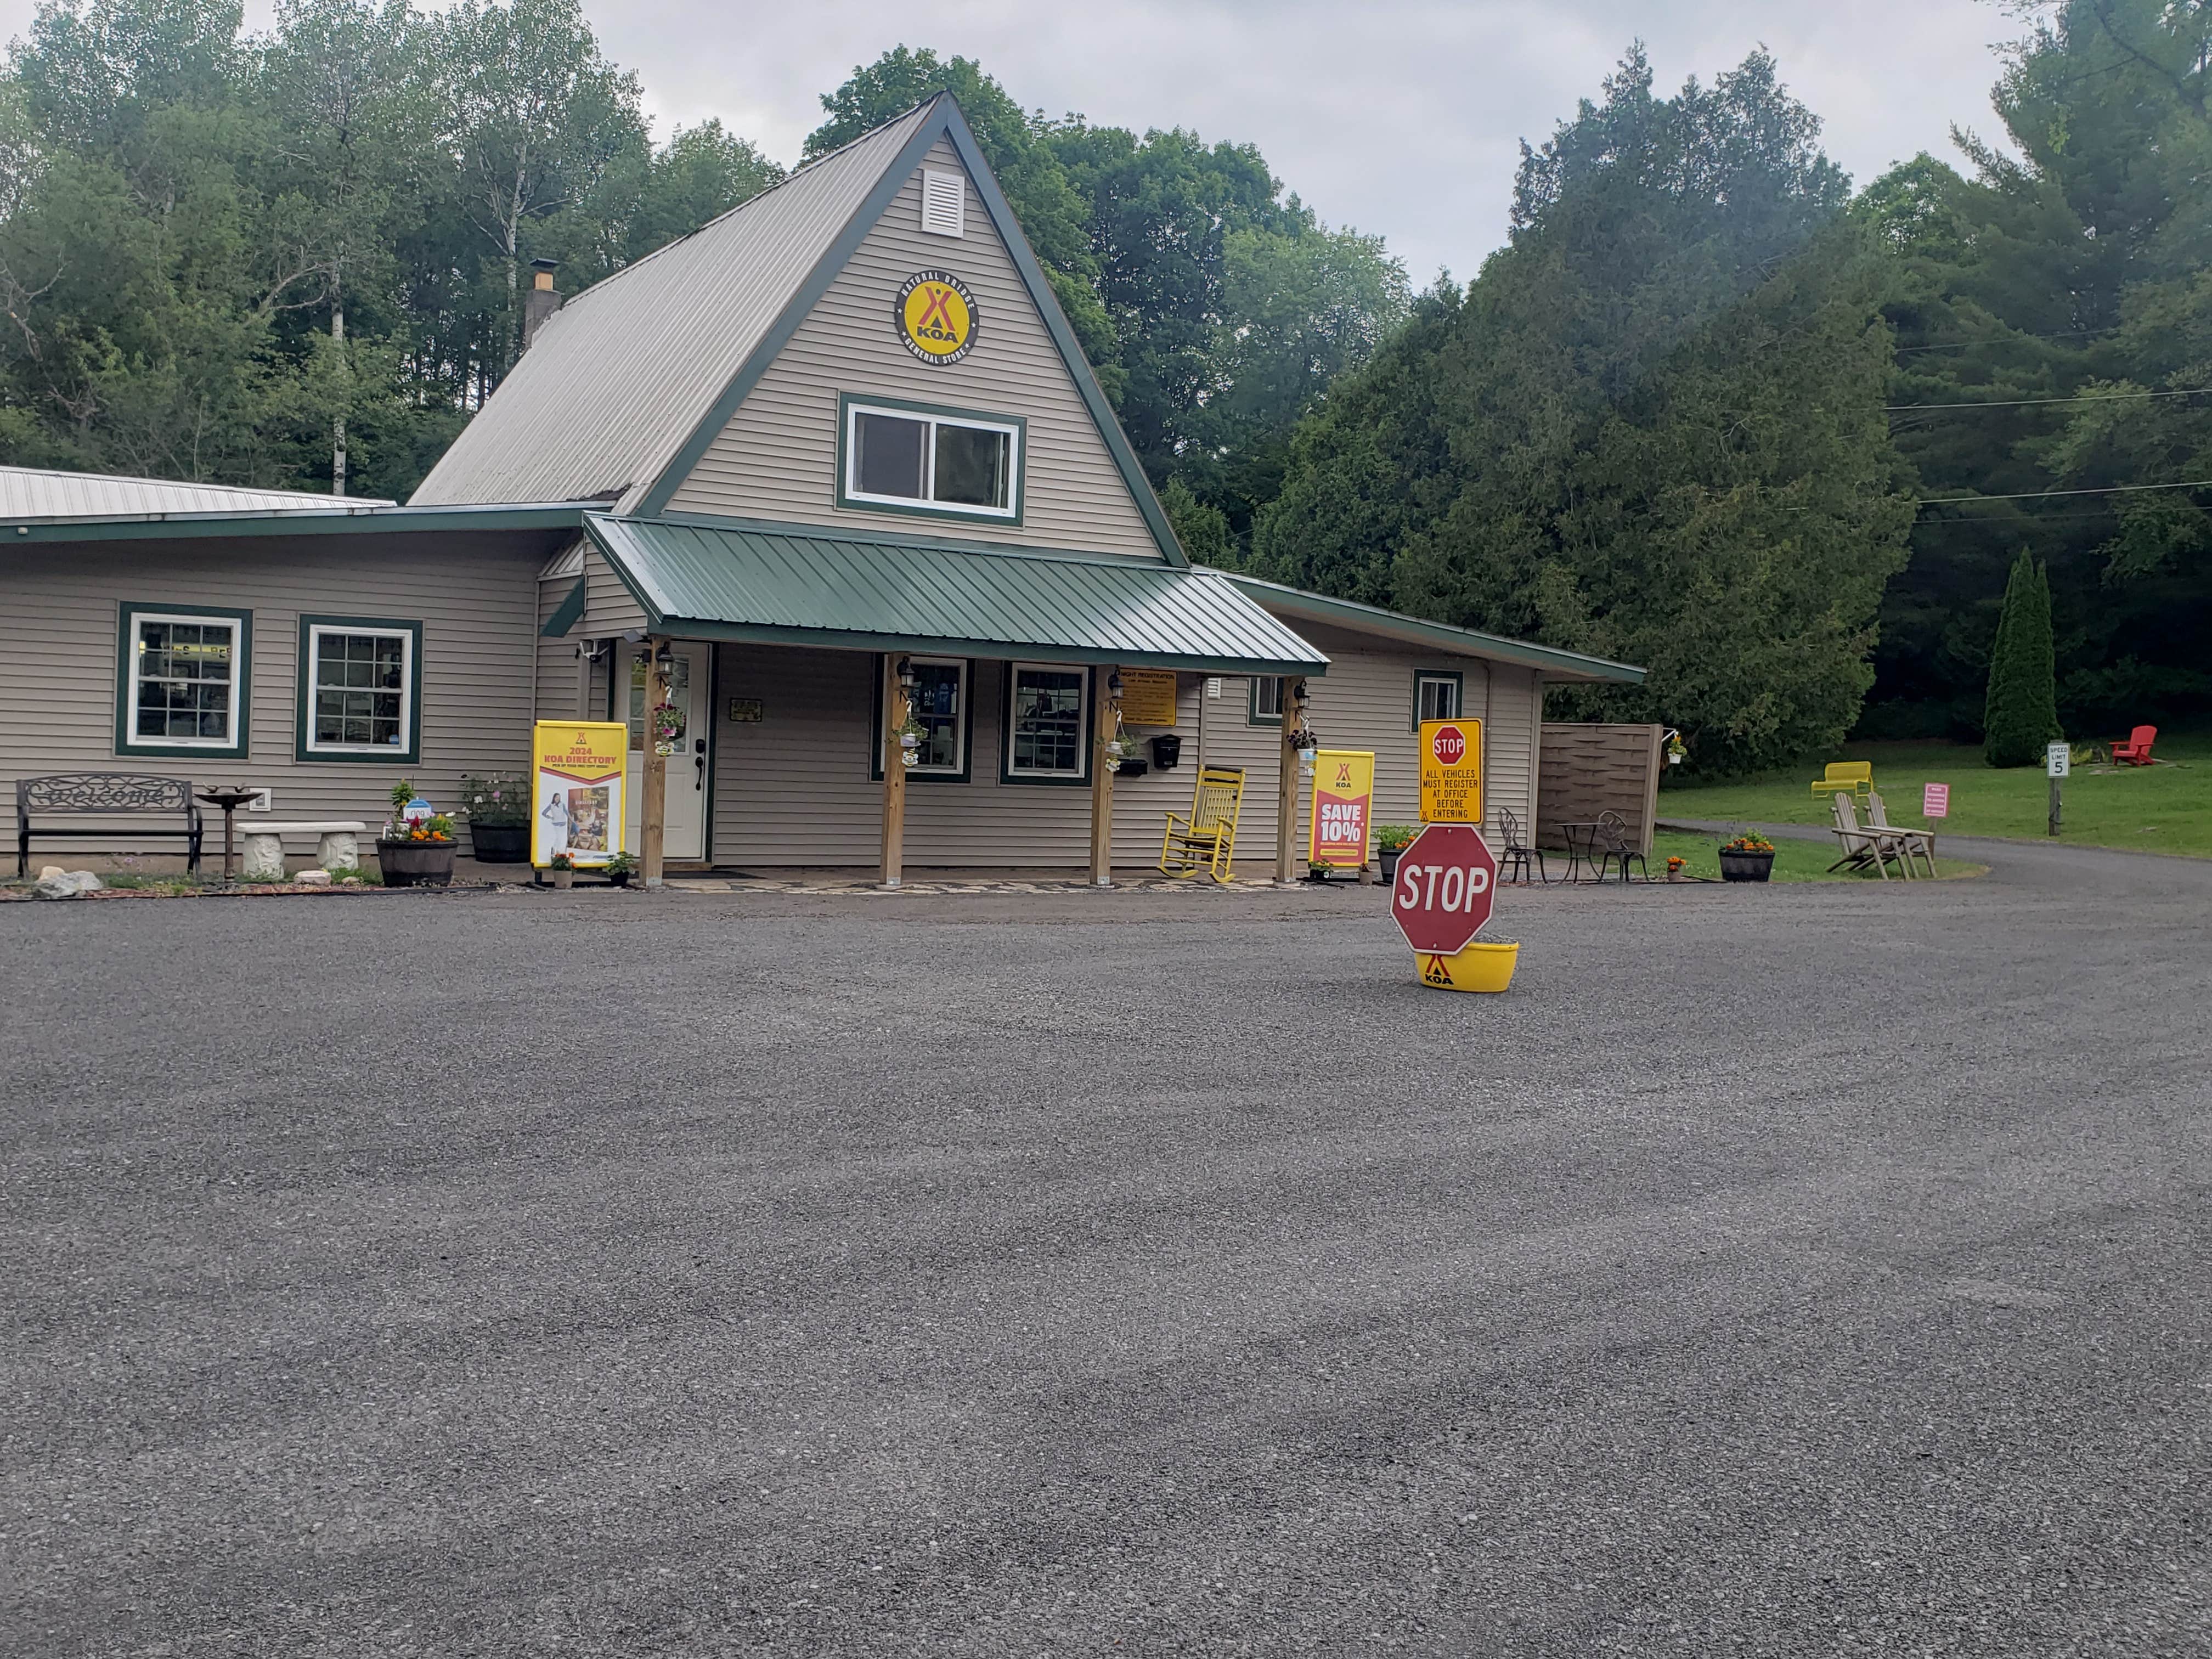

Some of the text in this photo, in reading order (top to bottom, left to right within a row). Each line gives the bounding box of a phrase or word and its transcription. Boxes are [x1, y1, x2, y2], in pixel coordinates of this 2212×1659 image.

[901, 272, 975, 310] NATURAL BRIDGE
[917, 326, 959, 343] KOA
[905, 337, 967, 364] GENERAL STORE
[1138, 672, 1175, 680] REGISTRATION
[1435, 738, 1464, 754] STOP
[544, 755, 617, 764] KOA DIRECTORY
[2055, 761, 2063, 774] 5
[1426, 769, 1475, 778] ALL VEHICLES
[1423, 779, 1477, 788] MUST REGISTER
[1432, 789, 1468, 798] AT OFFICE
[1437, 799, 1464, 808] BEFORE
[1322, 804, 1361, 821] SAVE
[1433, 809, 1468, 819] ENTERING
[1399, 864, 1489, 913] STOP
[1425, 974, 1454, 985] KOA
